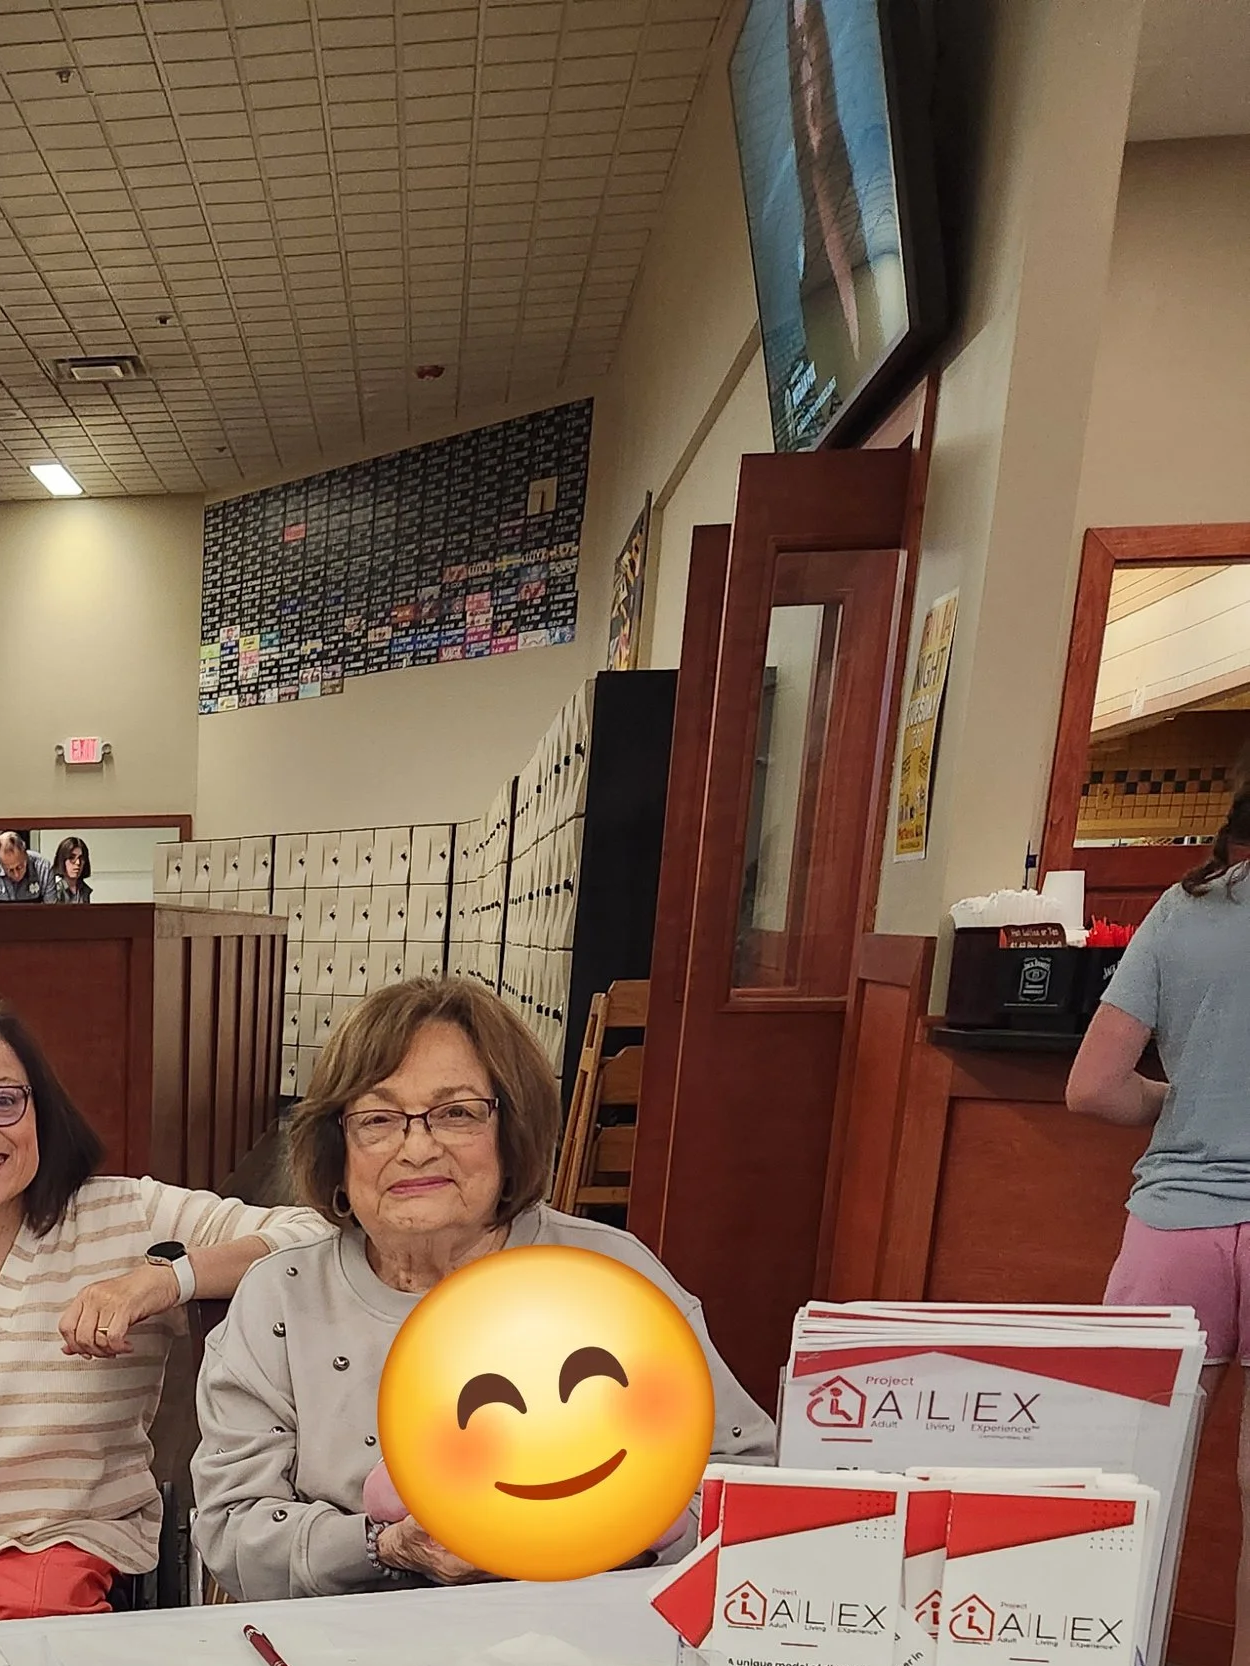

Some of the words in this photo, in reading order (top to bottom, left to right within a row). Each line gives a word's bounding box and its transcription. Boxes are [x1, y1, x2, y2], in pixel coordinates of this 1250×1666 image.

[71, 739, 97, 761] EXIT
[865, 1375, 914, 1387] Project
[870, 1420, 898, 1429] Adult
[925, 1422, 955, 1433] Living
[771, 1587, 798, 1597] Project
[804, 1624, 826, 1632] Living
